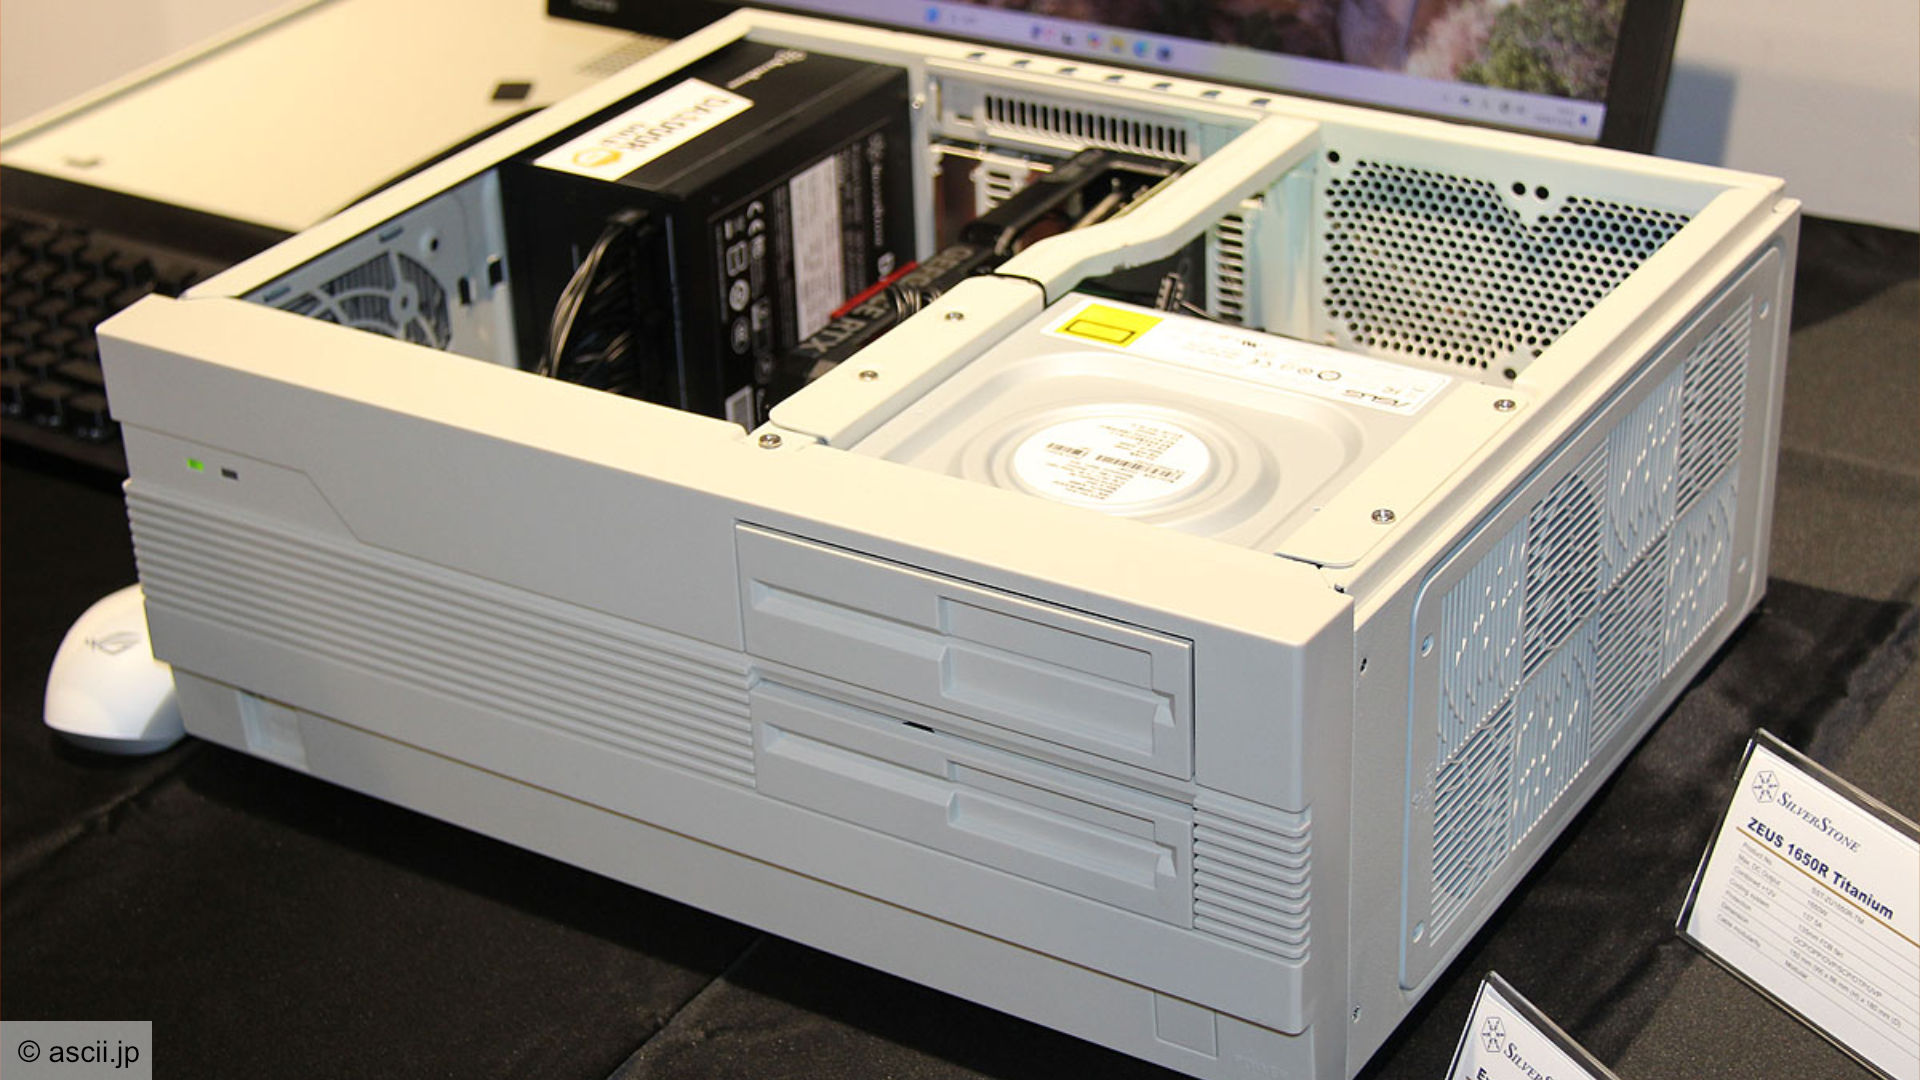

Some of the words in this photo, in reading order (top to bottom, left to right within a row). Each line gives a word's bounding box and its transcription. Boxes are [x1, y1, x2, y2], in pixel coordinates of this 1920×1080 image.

[799, 316, 868, 353] RTX
[1747, 816, 1785, 849] ZEUS
[1787, 843, 1830, 879] 1650R
[1832, 871, 1895, 921] Titanium
